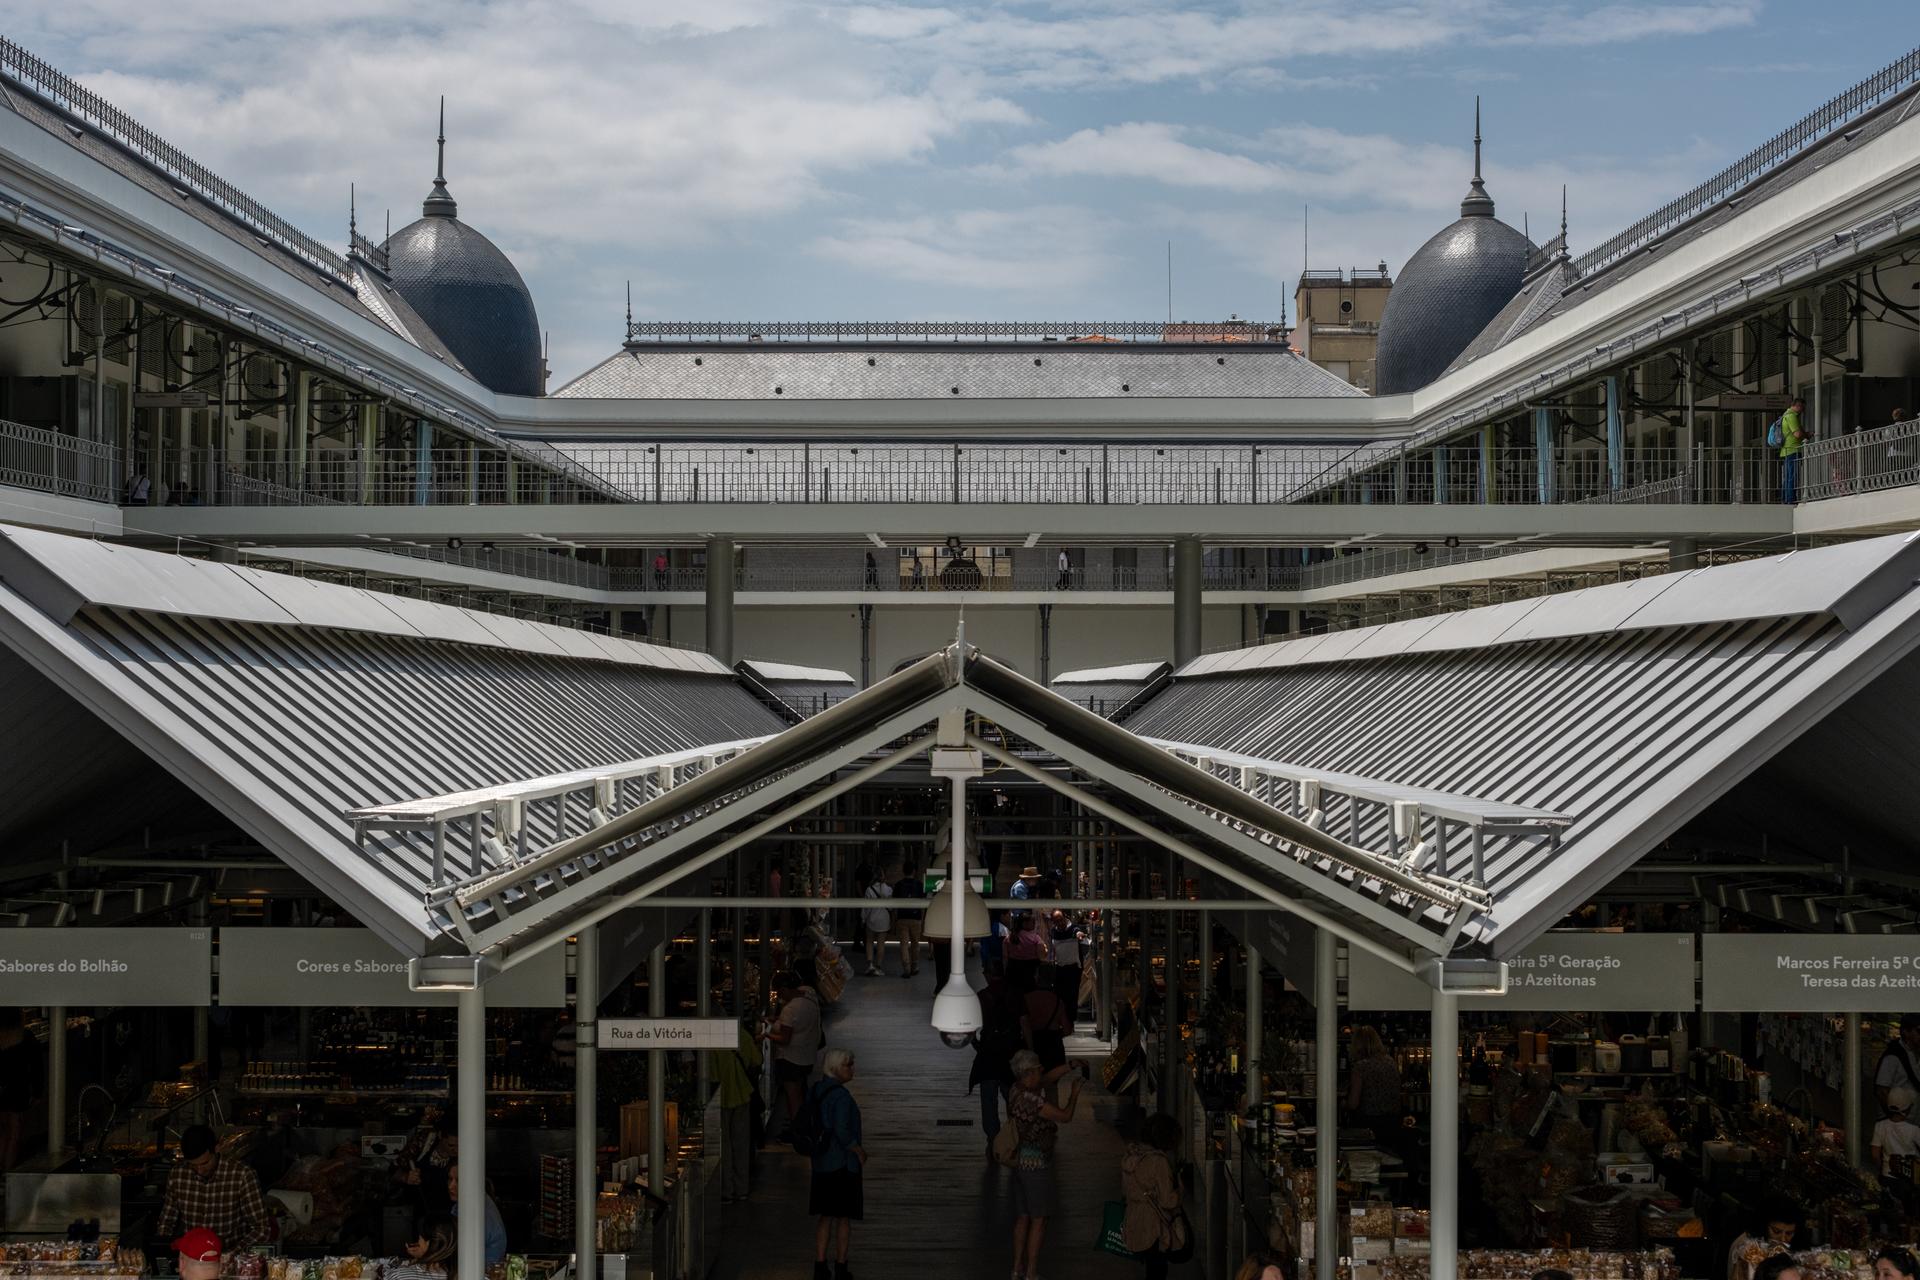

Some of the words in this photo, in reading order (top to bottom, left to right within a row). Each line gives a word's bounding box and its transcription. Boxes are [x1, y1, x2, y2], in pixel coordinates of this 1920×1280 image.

[0, 959, 55, 973] Sabores
[57, 959, 77, 973] do
[79, 959, 128, 973] Bolhão
[296, 959, 340, 973] Cores
[342, 963, 352, 973] e
[354, 959, 409, 973] Sabores
[1538, 954, 1555, 968] 5ª
[1558, 954, 1621, 971] Geração
[1776, 956, 1830, 969] Marcos
[1833, 956, 1890, 970] Ferreira
[1892, 956, 1909, 970] 5ª
[1524, 973, 1597, 987] Azeitonas
[1800, 973, 1848, 988] Teresa
[1851, 974, 1877, 988] das
[611, 1027, 633, 1039] Rua
[635, 1027, 651, 1039] da
[653, 1027, 693, 1039] Vitória
